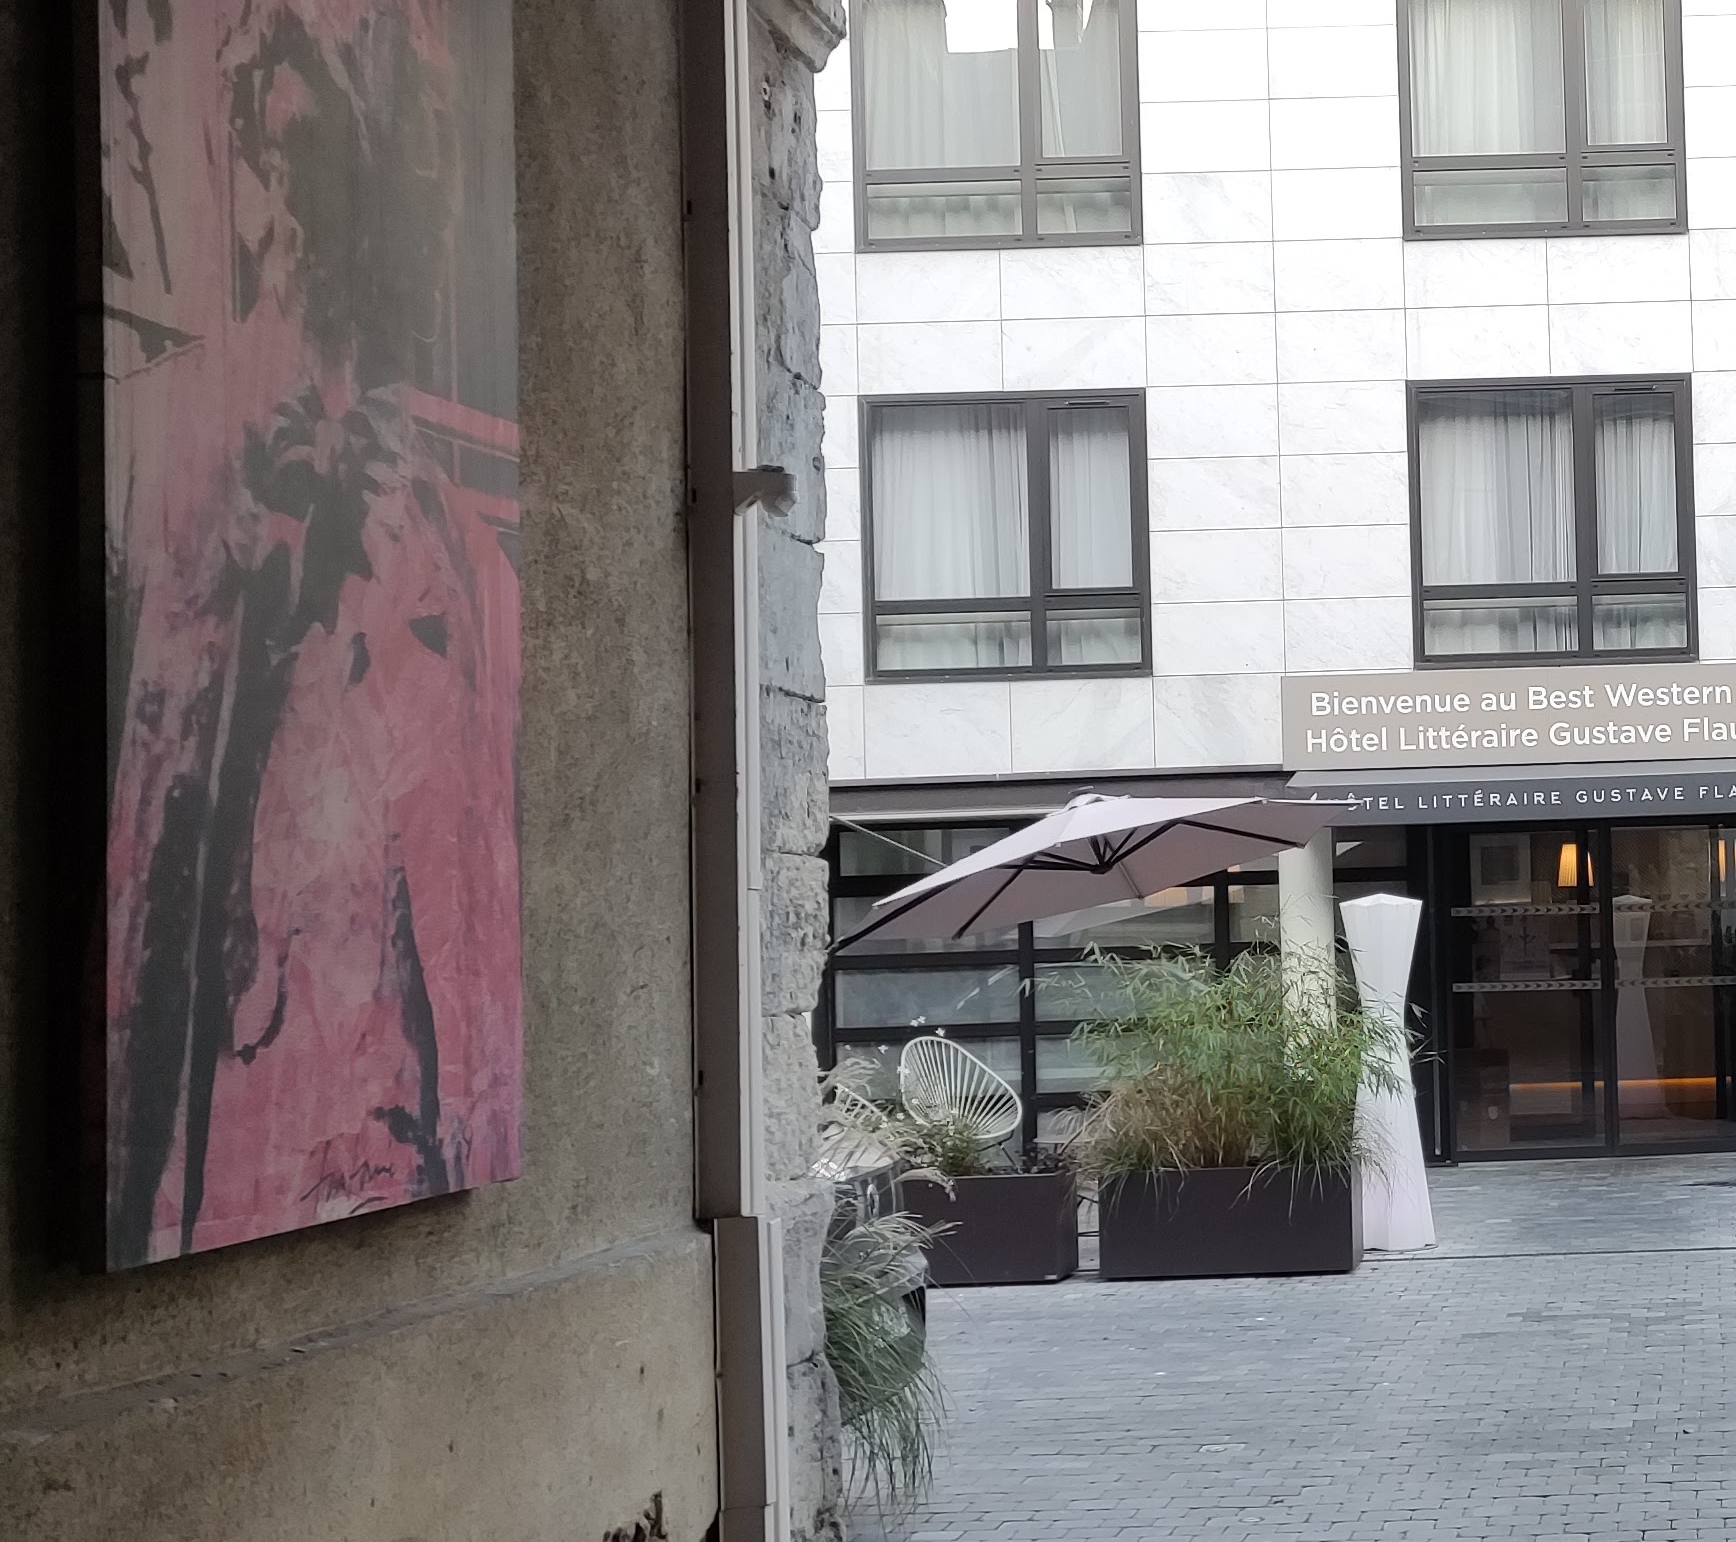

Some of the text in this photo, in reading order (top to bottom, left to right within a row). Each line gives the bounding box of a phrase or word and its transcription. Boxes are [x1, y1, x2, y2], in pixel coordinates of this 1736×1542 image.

[1311, 692, 1470, 716] Bienvenue
[1480, 692, 1516, 711] au
[1528, 686, 1595, 710] Best
[1605, 683, 1732, 708] Western
[1306, 727, 1387, 753] Hôtel
[1400, 723, 1539, 751] Littéraire
[1549, 721, 1672, 746] Gustave
[1418, 789, 1562, 809] LITTÉRAIRE
[1575, 787, 1685, 804] GUSTAVE
